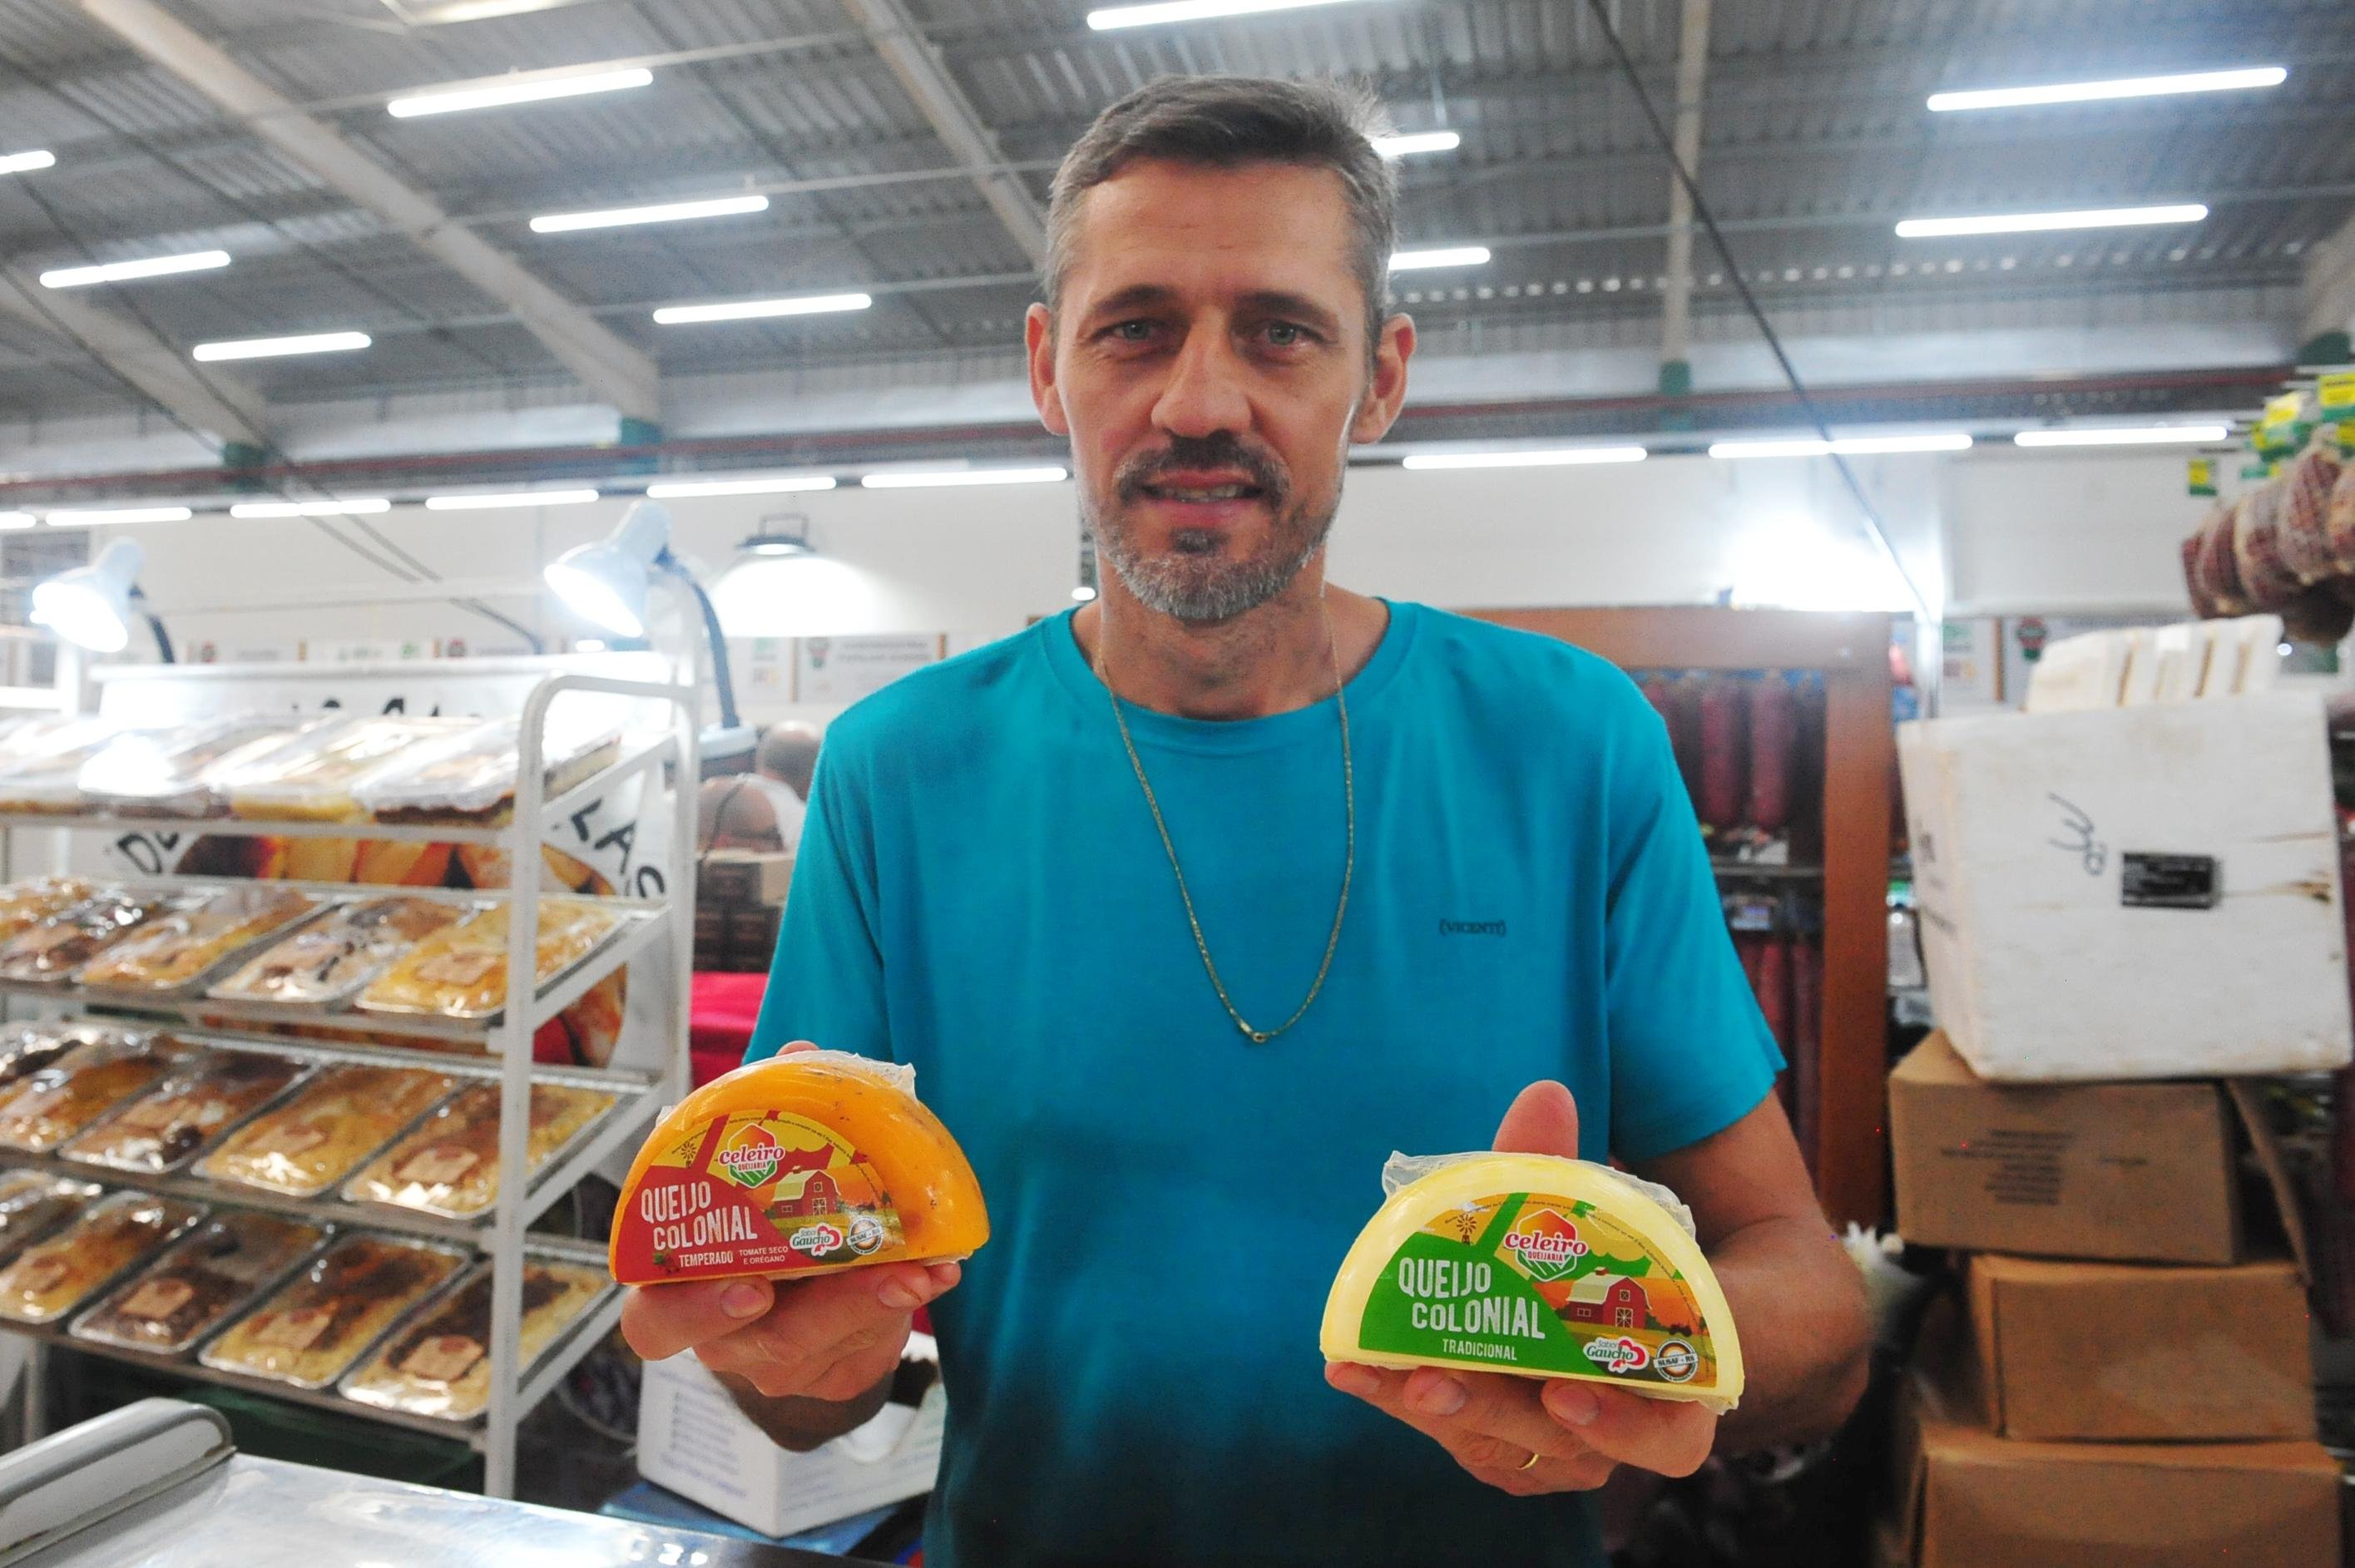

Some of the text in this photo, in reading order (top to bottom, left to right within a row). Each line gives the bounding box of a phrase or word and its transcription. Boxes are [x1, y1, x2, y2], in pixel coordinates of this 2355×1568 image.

[720, 1145, 784, 1164] celeiro
[641, 1181, 711, 1224] QUEIJO
[653, 1205, 758, 1250] COLONIAL
[792, 1233, 831, 1247] Gaucho
[1505, 1232, 1587, 1255] celeiro
[678, 1250, 734, 1268] TEMPERADO
[739, 1246, 789, 1256] TOMATE SECO
[1527, 1250, 1564, 1262] QUEIJARIA
[1398, 1257, 1492, 1298] QUEIJO
[1412, 1296, 1546, 1339] COLONIAL
[1442, 1338, 1517, 1361] TRADICIONAL
[1586, 1344, 1634, 1361] Gaucho
